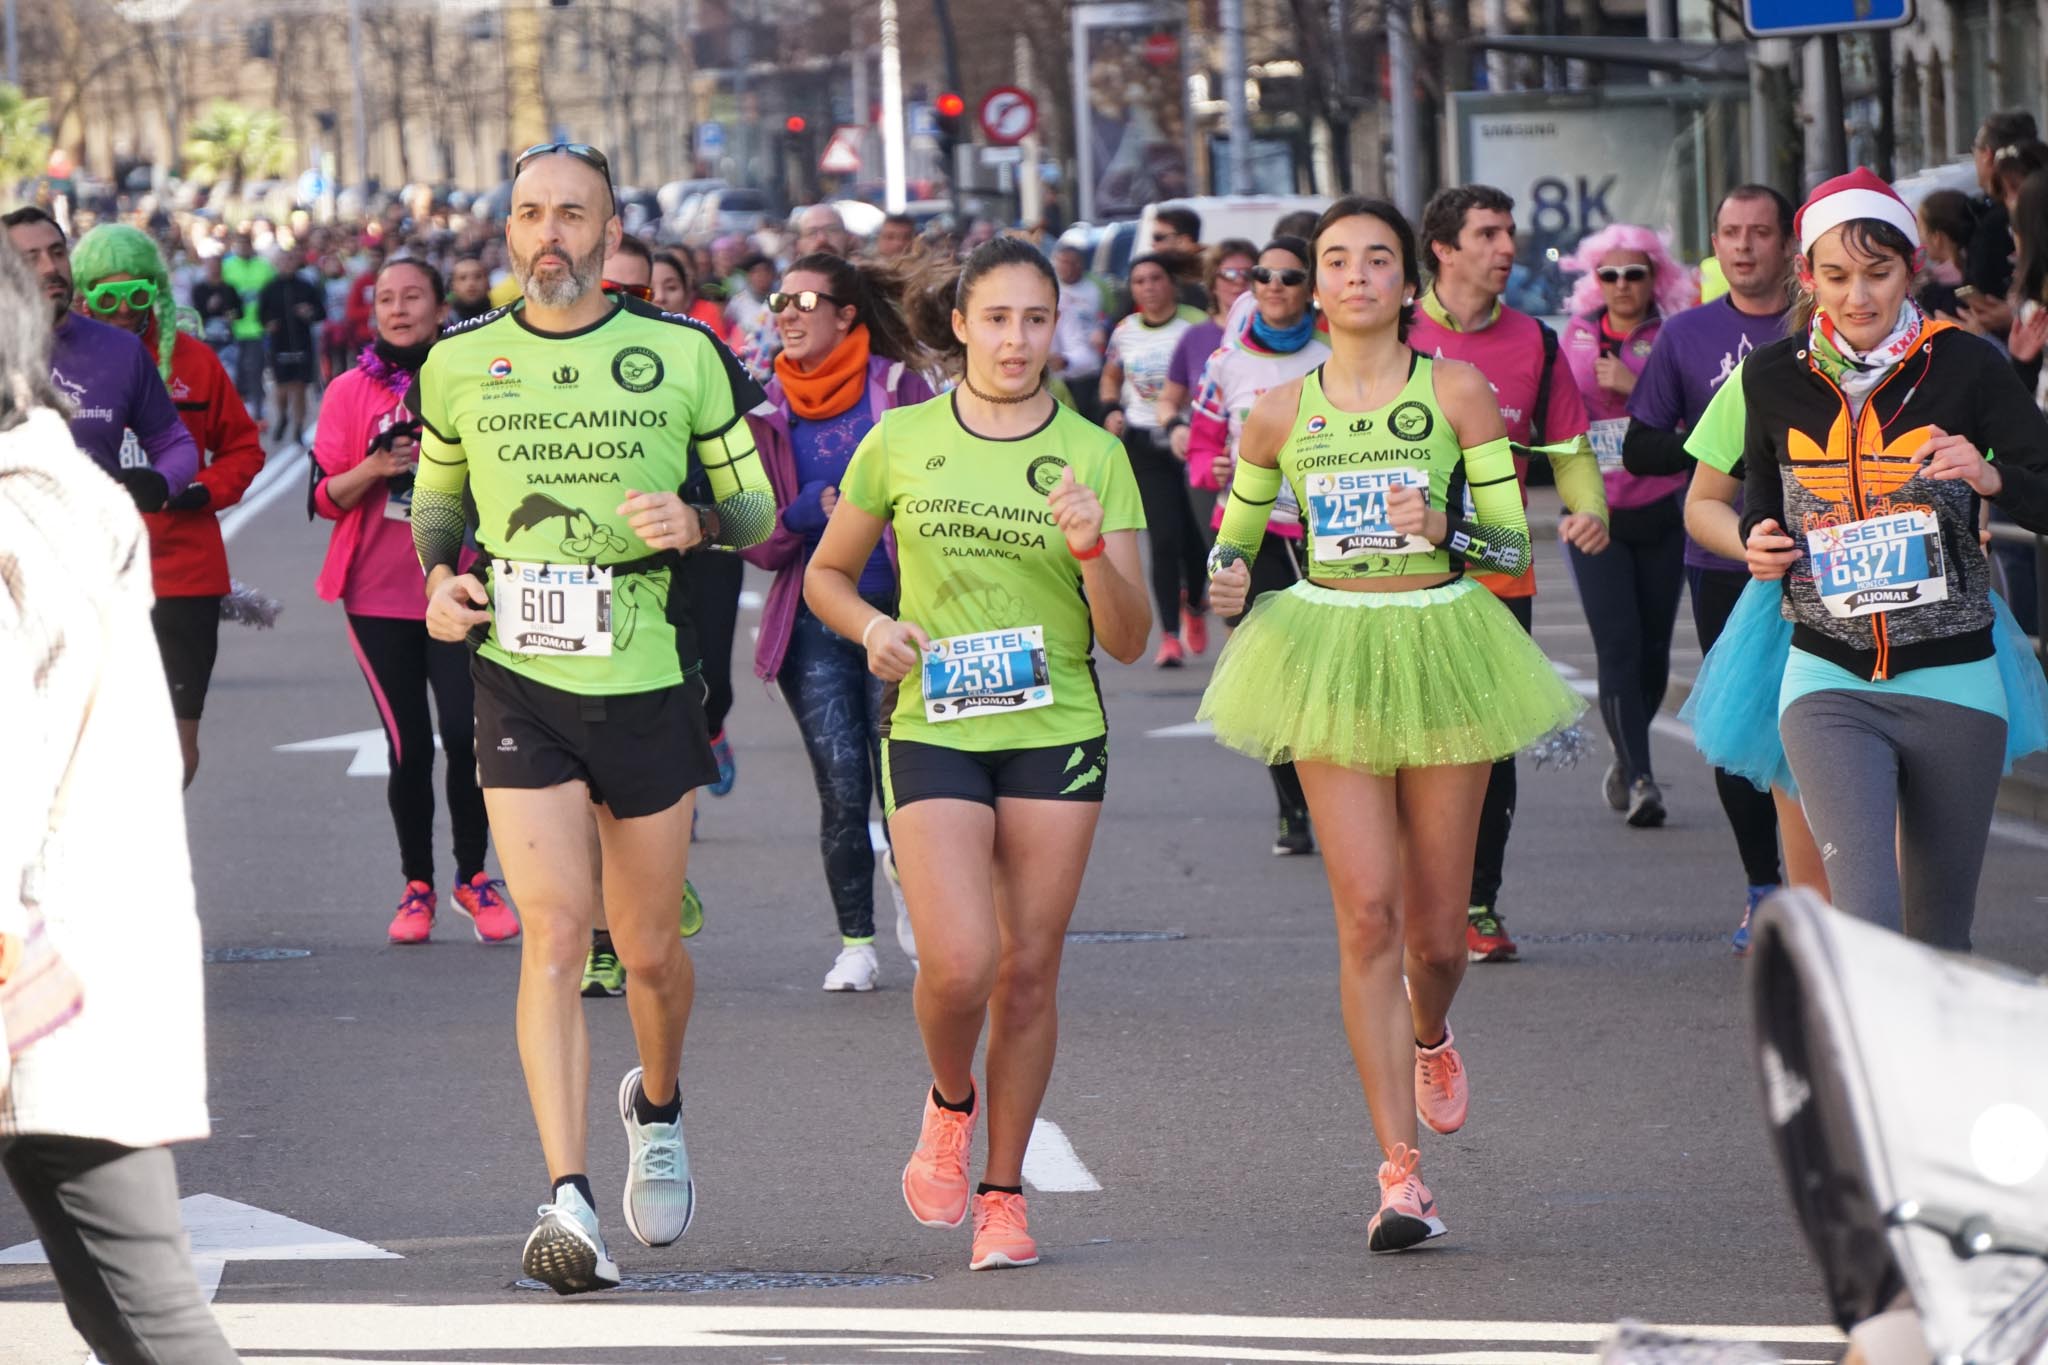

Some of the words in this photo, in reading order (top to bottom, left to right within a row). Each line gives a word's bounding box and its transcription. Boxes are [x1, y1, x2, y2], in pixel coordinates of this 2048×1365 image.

[1532, 175, 1618, 236] 8K
[443, 305, 506, 333] MINO
[476, 409, 669, 433] CORRECAMINOS
[497, 441, 645, 462] CARBAJOSA
[1296, 448, 1432, 472] CORRECAMINOS
[526, 472, 621, 484] SALAMANCA
[1338, 471, 1417, 490] SETEL
[905, 498, 1058, 527] CORRECAMINO
[919, 522, 1047, 550] CARBAJOSA
[1844, 517, 1924, 544] SETEL
[942, 546, 1021, 561] SALAMANCA
[1348, 538, 1397, 549] ALJOMAR
[1830, 538, 1908, 587] 6327
[522, 568, 600, 585] SETEL
[521, 587, 565, 624] 610
[1857, 591, 1909, 605] ALJOMAR
[526, 634, 574, 651] ALJOMAR
[944, 653, 1014, 695] 2531
[964, 696, 1016, 707] ALJOMAR
